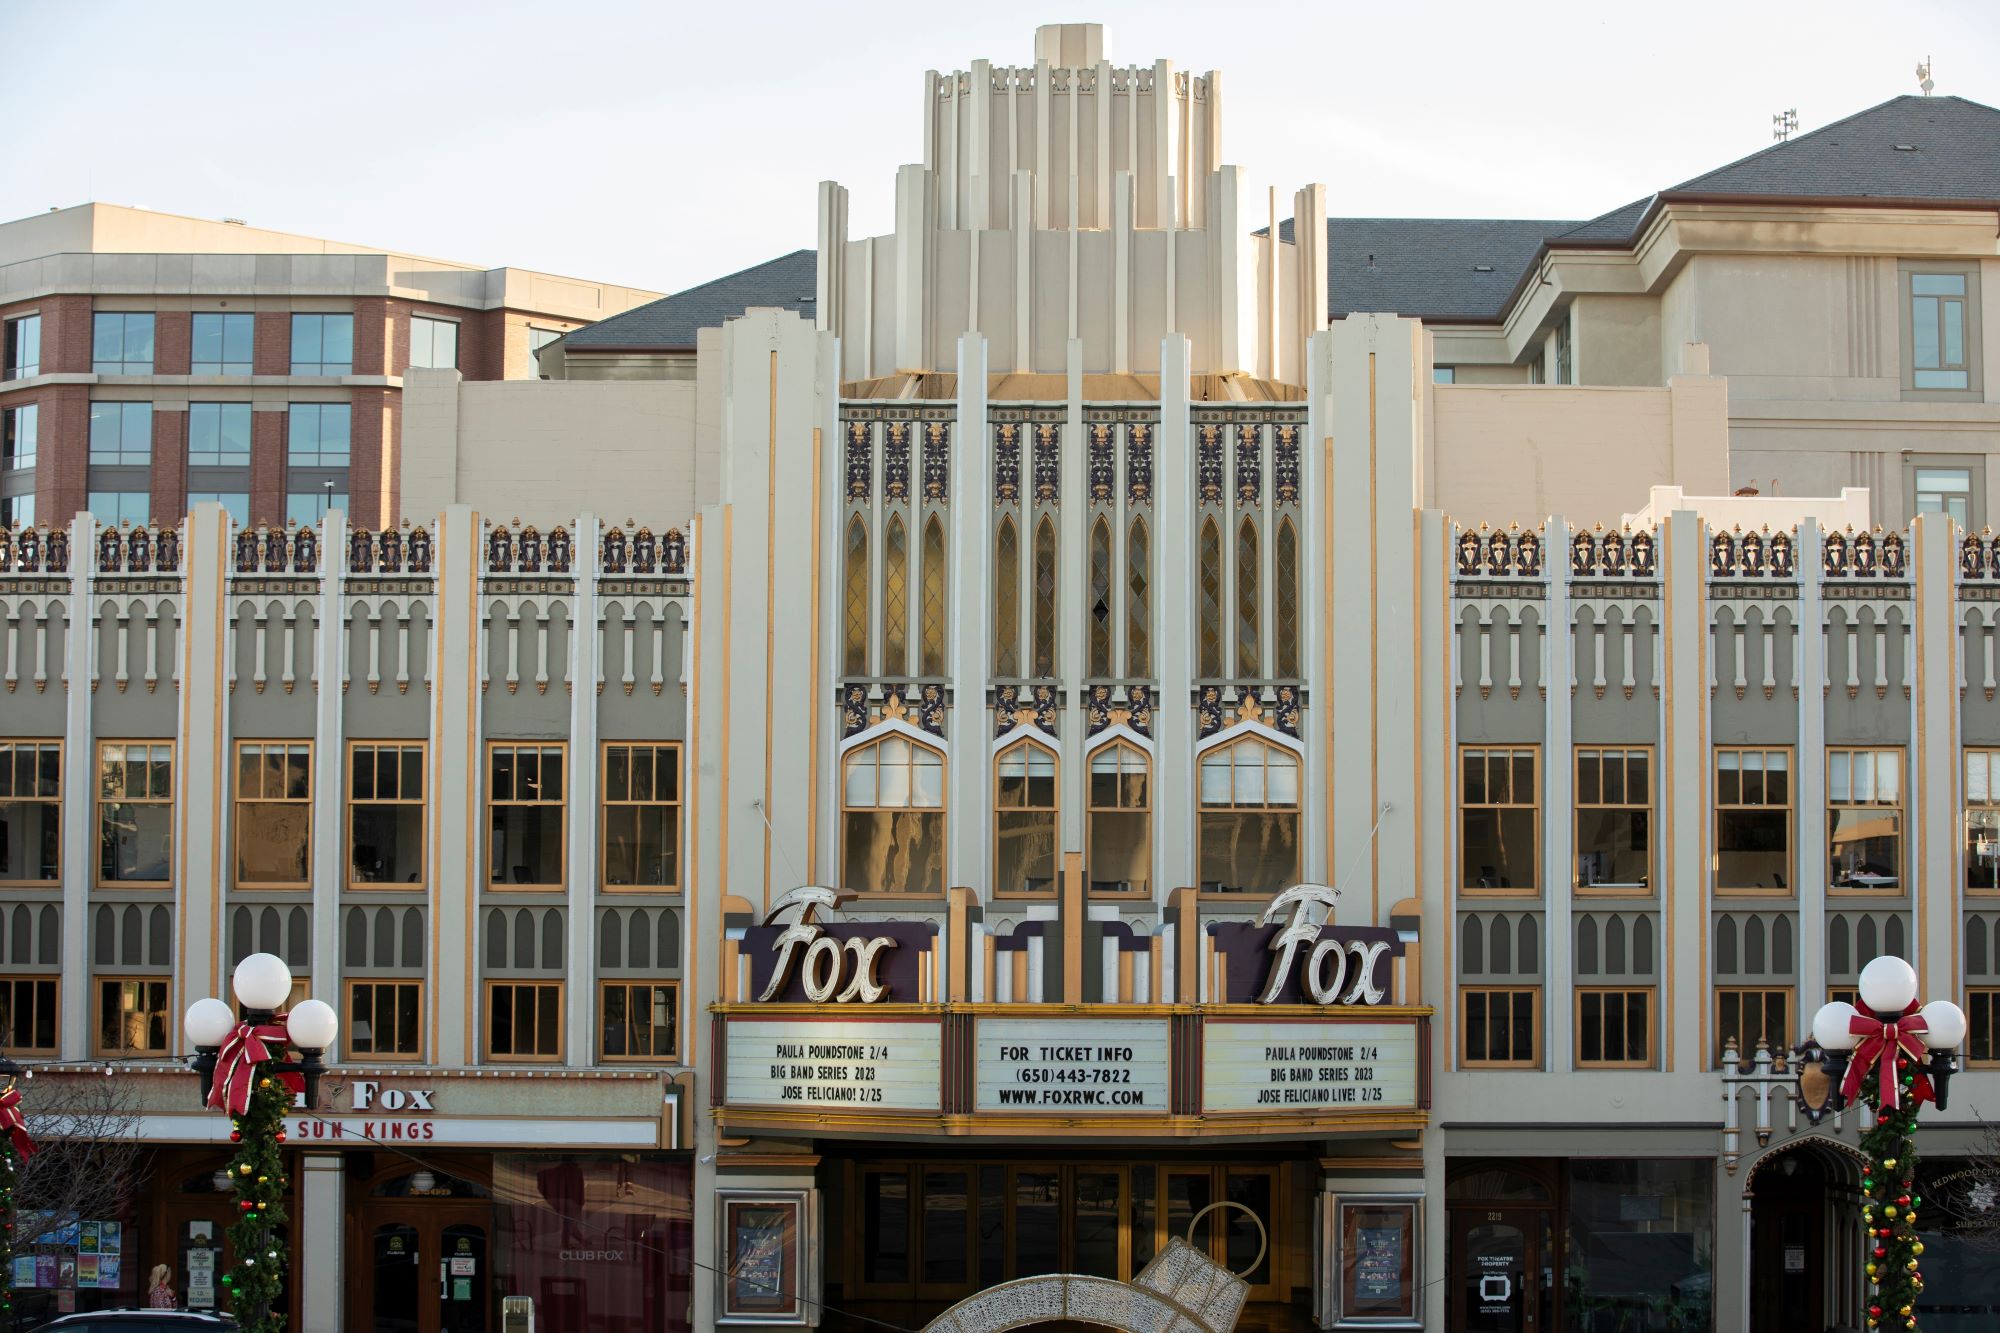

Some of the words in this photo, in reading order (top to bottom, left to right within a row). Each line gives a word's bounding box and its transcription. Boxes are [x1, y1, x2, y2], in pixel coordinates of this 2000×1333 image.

[758, 885, 896, 1003] Fox
[1257, 883, 1391, 1005] Fox
[776, 1044, 804, 1059] PAULA
[808, 1044, 865, 1060] POUNDSTONE
[869, 1046, 888, 1060] 2/4
[1000, 1046, 1029, 1061] FOR
[1039, 1046, 1092, 1061] TICKET
[1097, 1047, 1133, 1061] INFO
[1265, 1047, 1296, 1061] PAULA
[1299, 1047, 1354, 1061] POUNDSTONE
[1360, 1046, 1377, 1060] 2/4
[770, 1065, 786, 1079] BIG
[790, 1065, 814, 1079] BAND
[817, 1066, 848, 1080] SERIES
[854, 1066, 875, 1080] 2023
[1016, 1068, 1131, 1083] (650)443-7822
[1270, 1068, 1286, 1082] BIG
[1290, 1068, 1313, 1082] BAND
[1318, 1067, 1349, 1081] SERIES
[1354, 1067, 1373, 1081] 2023
[781, 1086, 803, 1100] JOSE
[807, 1086, 856, 1101] FELICIANO!
[859, 1088, 882, 1102] 2/25
[999, 1089, 1144, 1105] WWW.FOXRWC.COM
[1257, 1089, 1281, 1103] JOSE
[1284, 1088, 1330, 1103] FELICIANO
[1332, 1088, 1356, 1102] LIVE!
[1361, 1087, 1382, 1101] 2/25
[298, 1120, 342, 1139] SUN
[364, 1121, 434, 1140] KINGS
[1488, 1212, 1502, 1221] 2219
[559, 1250, 595, 1261] CLUB
[597, 1250, 624, 1261] FOX
